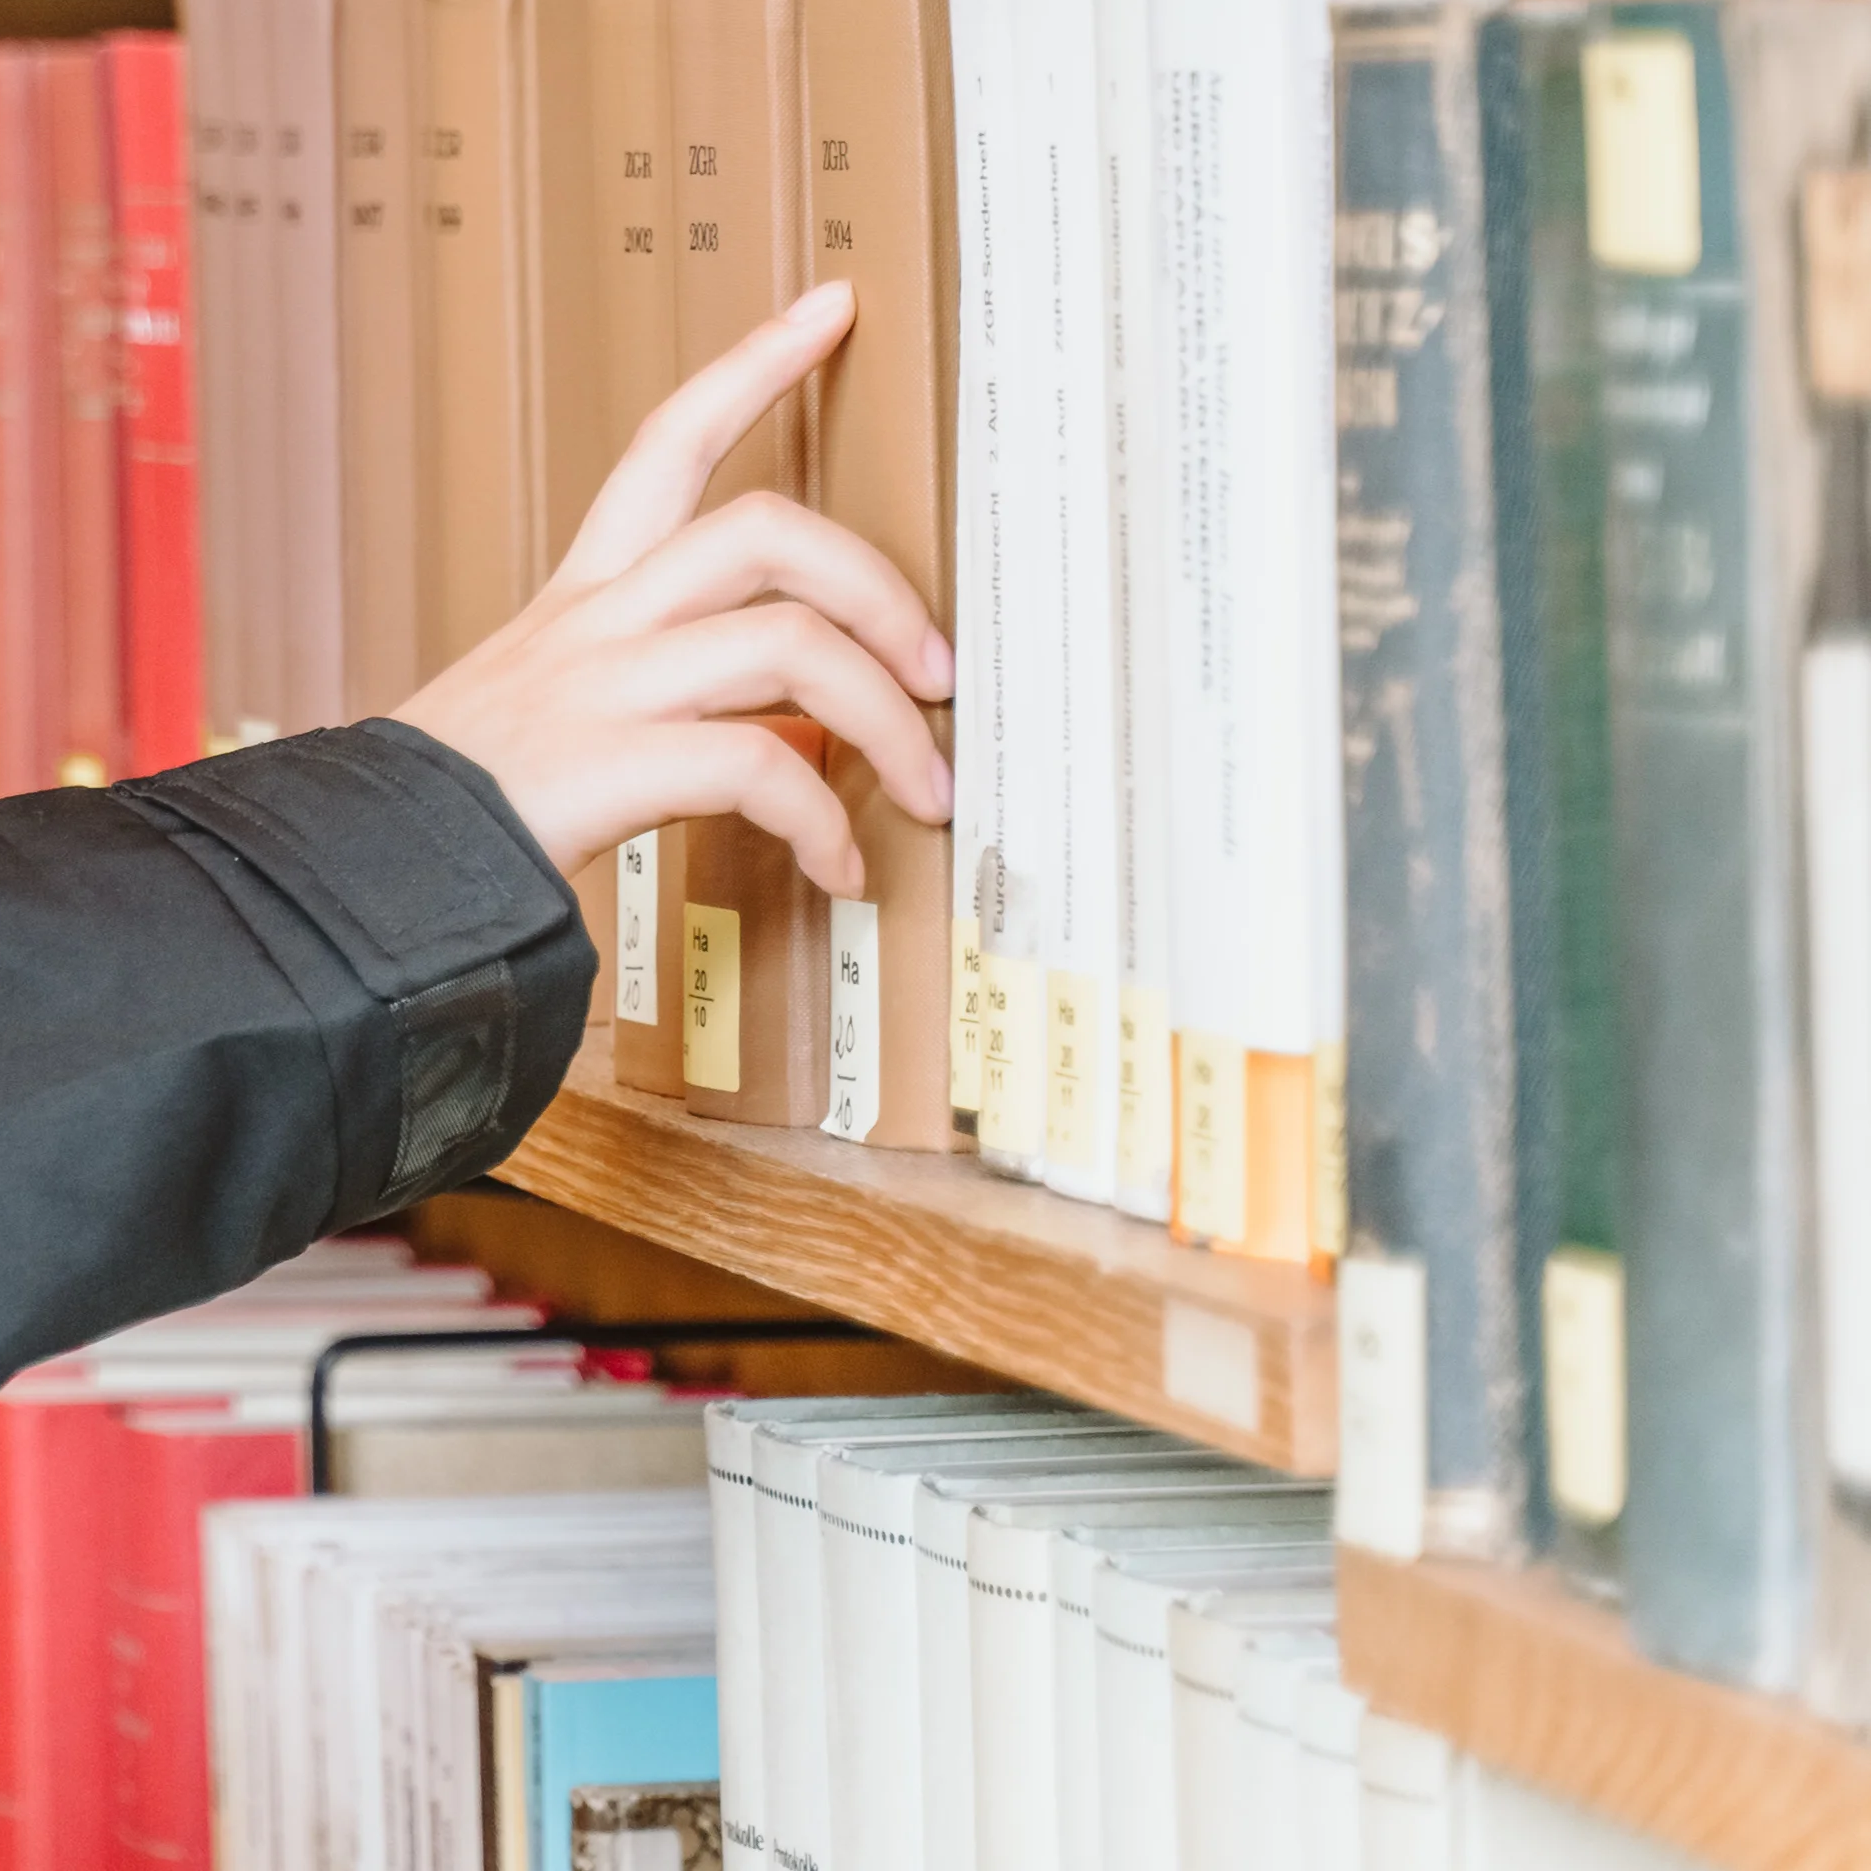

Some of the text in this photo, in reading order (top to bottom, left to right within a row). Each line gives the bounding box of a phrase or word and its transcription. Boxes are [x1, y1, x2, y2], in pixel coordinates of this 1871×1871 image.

[624, 151, 652, 178] ZGR
[688, 145, 717, 176] ZGR
[822, 139, 850, 171] ZGR
[624, 226, 653, 254] 2002
[689, 222, 718, 251] 2003
[824, 219, 853, 250] 2004
[626, 842, 642, 875] Ha
[692, 927, 709, 953] Ha
[841, 950, 859, 985] Ha
[965, 947, 980, 973] Ha
[694, 969, 707, 993] 20
[965, 992, 979, 1014] 20
[988, 984, 1006, 1011] Ha
[694, 1006, 706, 1029] 10
[835, 1014, 855, 1060] 20
[965, 1030, 976, 1052] 11
[990, 1030, 1003, 1053] 20
[990, 1068, 1003, 1091] 11
[835, 1089, 853, 1131] 10
